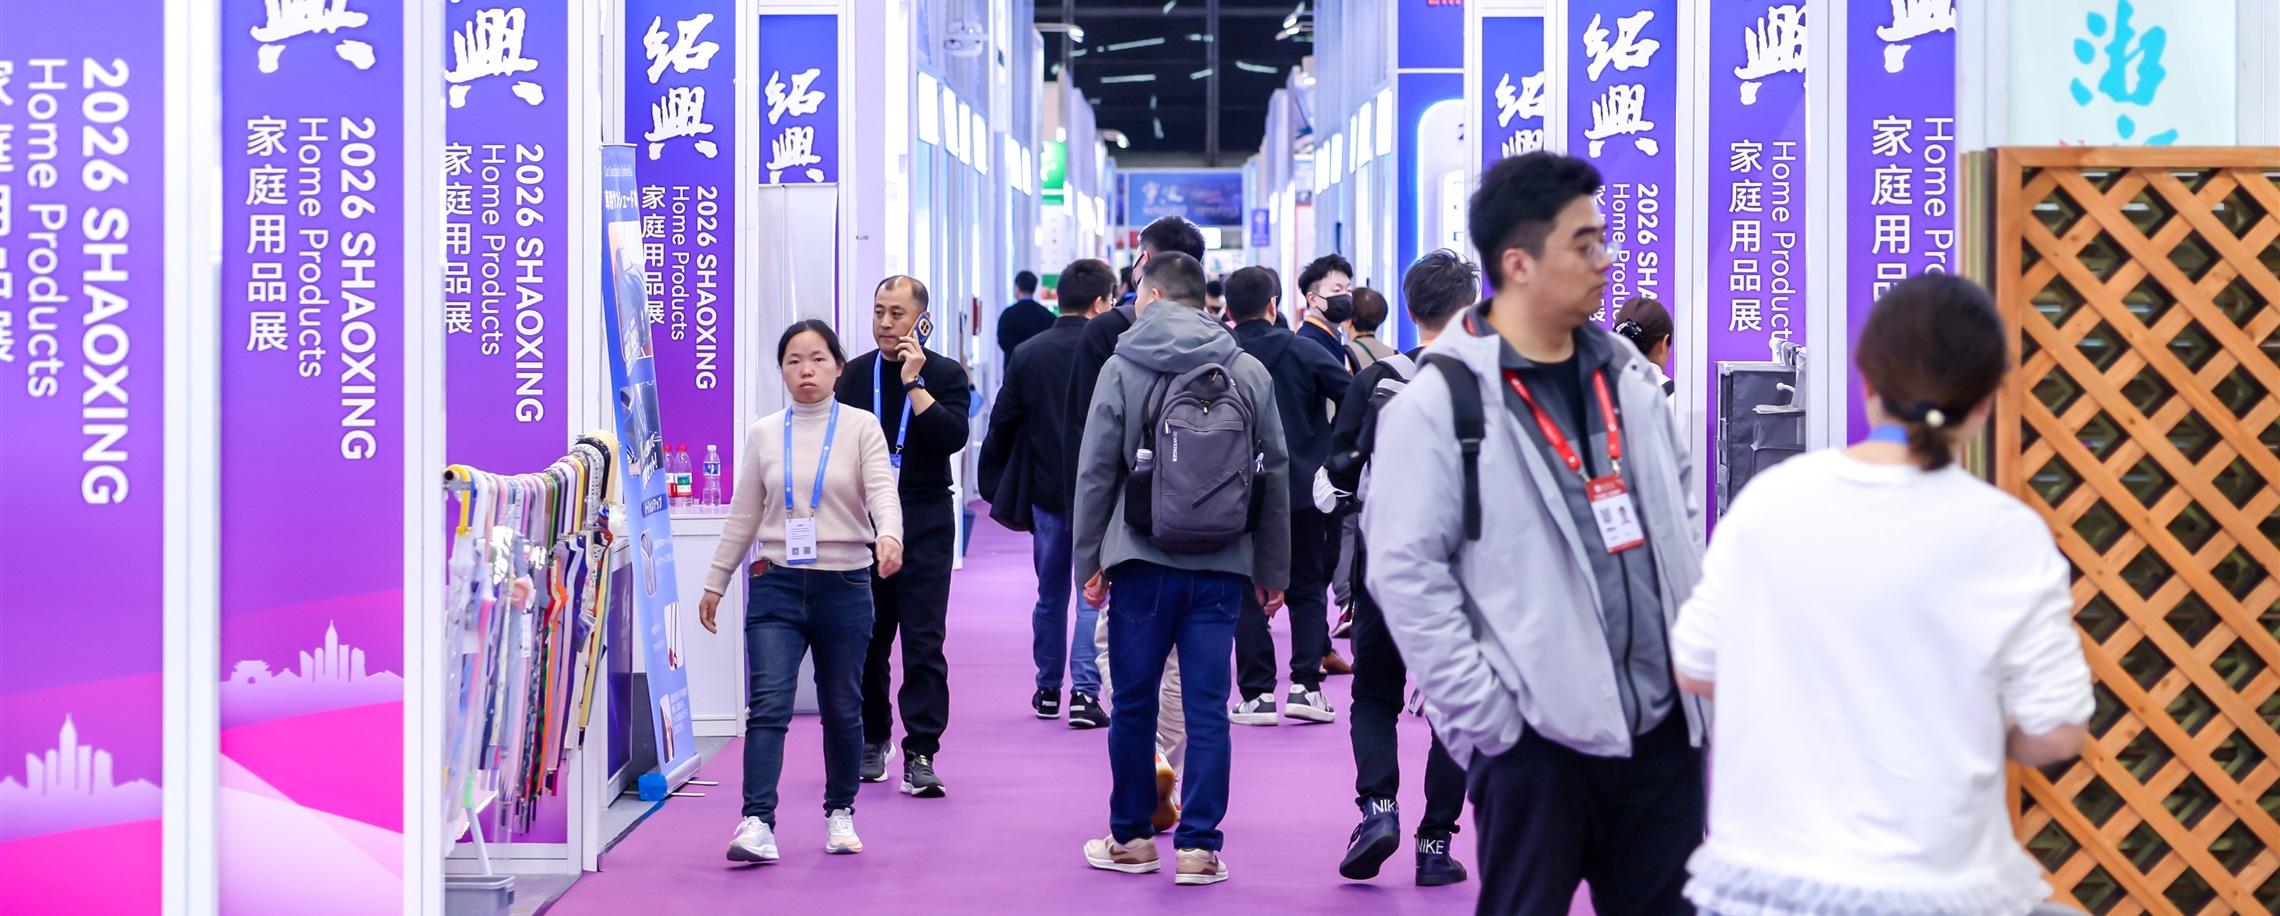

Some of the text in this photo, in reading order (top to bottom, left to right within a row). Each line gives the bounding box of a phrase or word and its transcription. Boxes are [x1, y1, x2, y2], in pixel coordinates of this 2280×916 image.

[27, 59, 69, 398] Home Products
[245, 114, 289, 352] 家庭用品展
[298, 117, 330, 378] Home Products
[445, 142, 473, 334] 家庭用品展
[481, 144, 507, 356] Home Products
[641, 184, 666, 326] 家庭用品展
[671, 186, 691, 341] Home Products
[1612, 183, 1631, 243] Home
[1636, 182, 1660, 245] 2026
[1728, 138, 1764, 332] 家庭用品展
[1771, 141, 1797, 223] Home
[1923, 117, 1954, 217] Home
[82, 57, 130, 505] 2026 SHAOXING
[340, 116, 377, 461] 2026 SHAOXING
[515, 143, 545, 423] 2026 SHAOXING
[695, 185, 719, 390] 2026 SHAOXING
[1371, 799, 1399, 815] NIK
